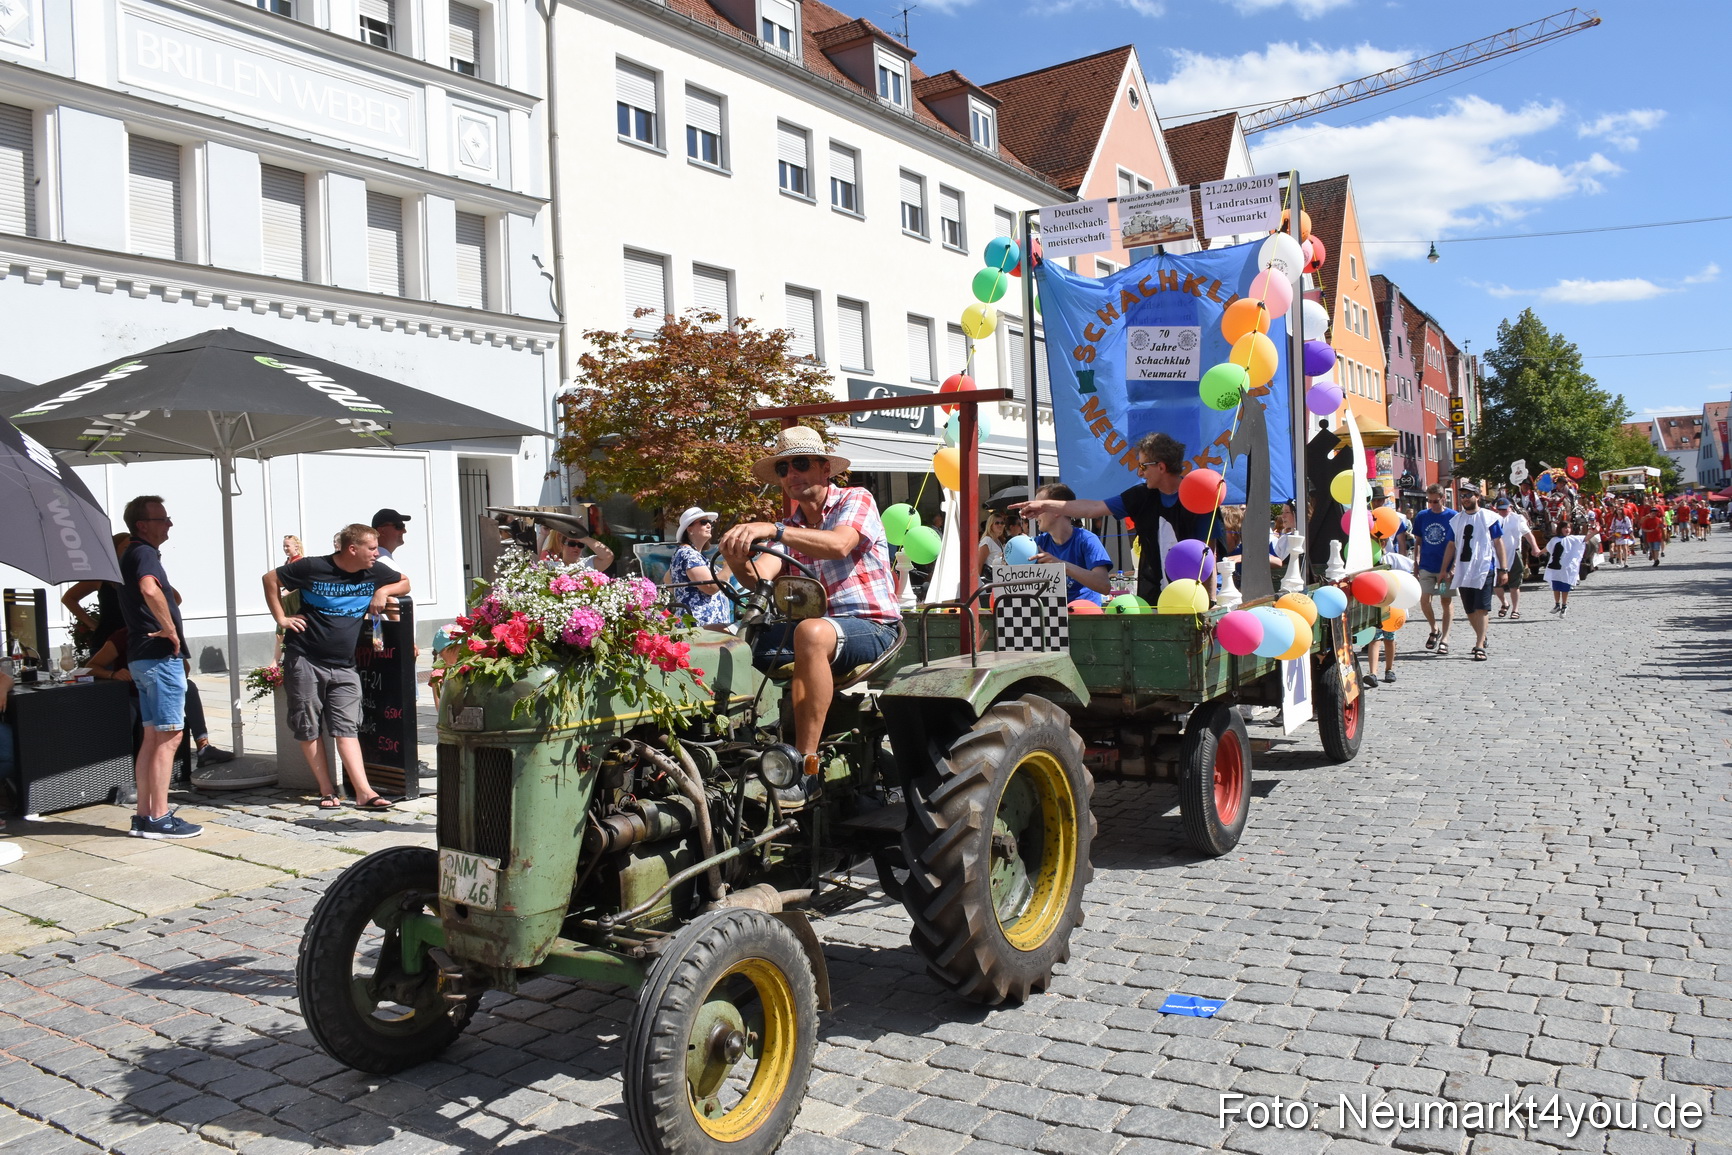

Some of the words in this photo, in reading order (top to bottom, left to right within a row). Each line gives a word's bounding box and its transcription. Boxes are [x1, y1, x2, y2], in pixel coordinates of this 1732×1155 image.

[136, 29, 282, 103] BRILLEN
[289, 74, 404, 137] WEBER
[1205, 178, 1274, 195] 21./22.09.2019
[1119, 195, 1144, 204] Deutsche
[1128, 198, 1165, 210] meisterschaft
[1209, 194, 1273, 210] Landratsamt
[1054, 205, 1093, 218] Deutsche
[1217, 210, 1267, 224] Neumarkt
[1043, 217, 1107, 234] Schnellschach-
[1047, 231, 1105, 248] meisterschaft
[1159, 329, 1170, 339] 70
[1150, 343, 1177, 352] Jahre
[1135, 355, 1191, 366] Schachklub
[1139, 369, 1187, 379] Neumarkt
[1451, 398, 1466, 463] HOTEL
[996, 567, 1061, 584] Schachklub
[1004, 582, 1057, 595] Neumakt
[454, 855, 478, 879] NM
[441, 874, 457, 898] DR
[468, 882, 490, 905] 46
